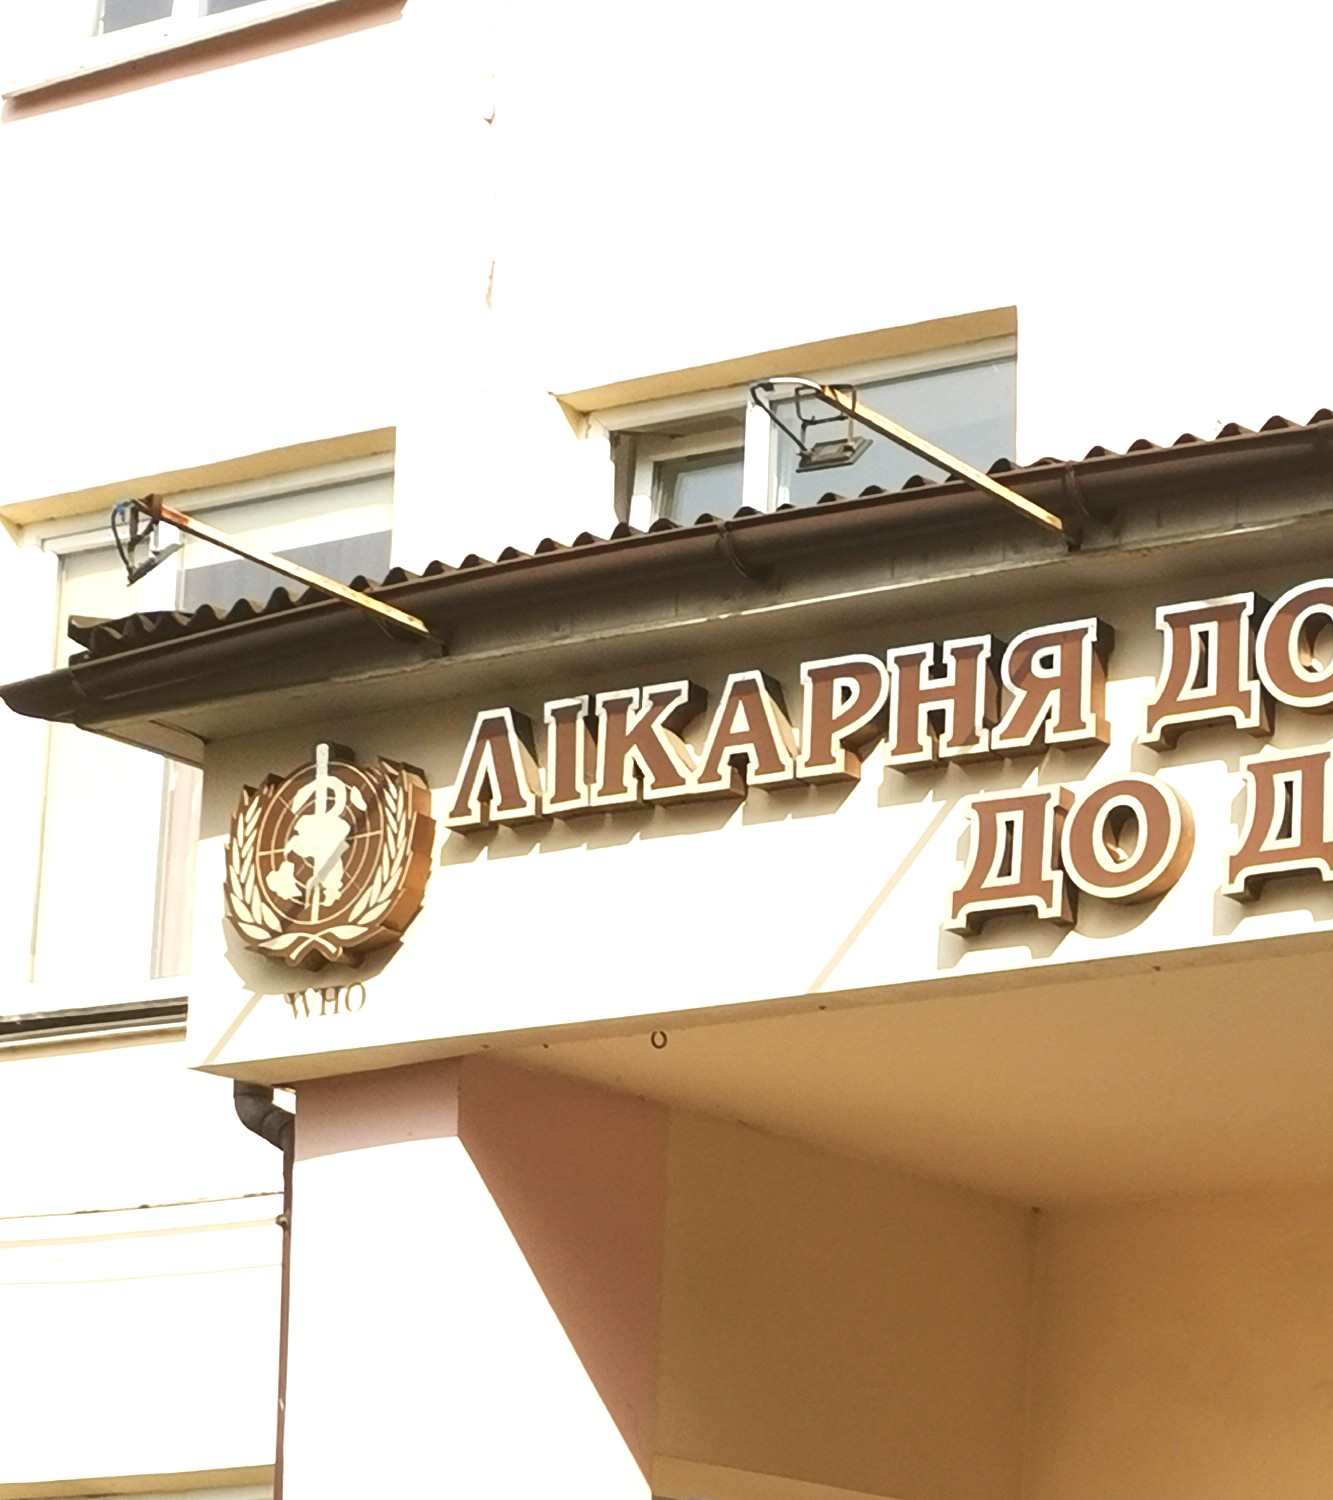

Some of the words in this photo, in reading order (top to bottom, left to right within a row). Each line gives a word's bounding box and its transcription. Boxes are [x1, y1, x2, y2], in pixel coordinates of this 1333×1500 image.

[446, 616, 1102, 828] ЛІКАРНЯ
[945, 776, 1188, 933] ДО
[284, 981, 367, 1020] WHO
